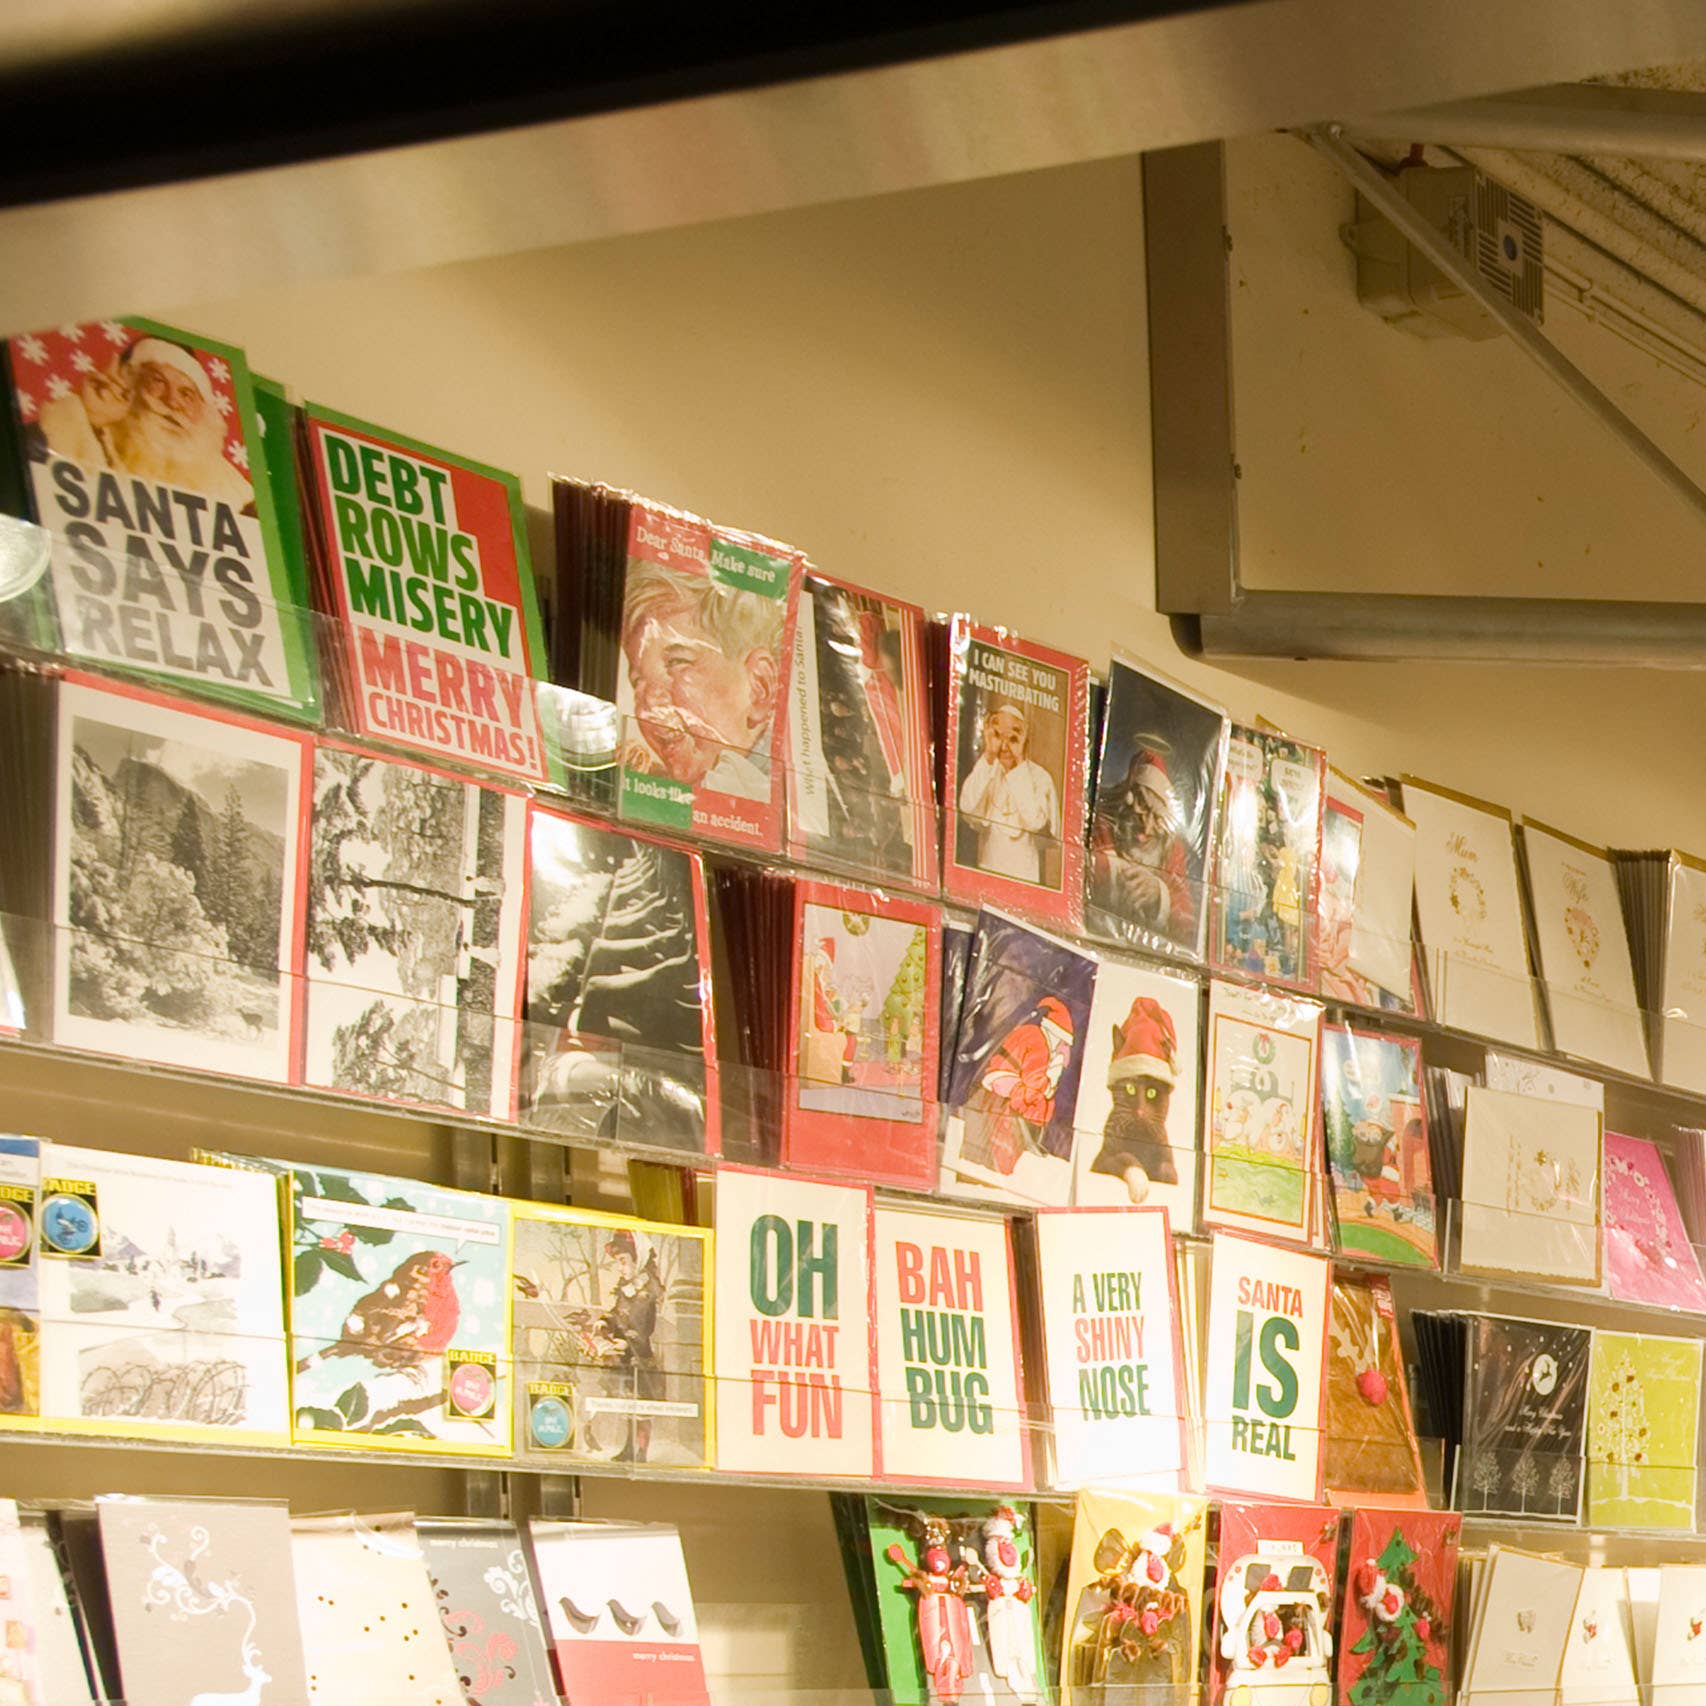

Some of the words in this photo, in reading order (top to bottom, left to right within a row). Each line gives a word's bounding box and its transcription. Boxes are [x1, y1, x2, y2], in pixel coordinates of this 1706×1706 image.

[53, 459, 250, 560] SANTA
[325, 434, 449, 526] DEBT
[334, 496, 480, 597] ROWS
[636, 526, 668, 555] Dear
[711, 548, 746, 575] Make
[747, 562, 776, 584] sure
[64, 521, 262, 631] SAYS
[347, 562, 515, 659] MISERY
[80, 599, 273, 688] RELAX
[972, 647, 981, 668] I
[982, 651, 1005, 675] CAN
[1006, 659, 1030, 683] SEE
[1032, 667, 1057, 691] YOU
[360, 631, 525, 724] MERRY
[968, 668, 1061, 714] MASTURBATING
[369, 692, 537, 771] CHRISTMAS!
[633, 778, 666, 800] looks
[692, 808, 709, 824] an
[710, 812, 764, 837] accident.
[749, 1214, 838, 1321] OH
[895, 1241, 984, 1309] BAH
[1072, 1274, 1087, 1314] A
[1093, 1272, 1143, 1314] VERY
[1237, 1276, 1304, 1318] SANTA
[750, 1319, 840, 1369] WHAT
[900, 1308, 988, 1370] HUM
[1074, 1316, 1145, 1363] SHINY
[1232, 1311, 1301, 1418] IS
[752, 1370, 842, 1440] FUN
[905, 1366, 993, 1435] BUG
[1078, 1364, 1151, 1421] NOSE
[1231, 1415, 1297, 1462] REAL
